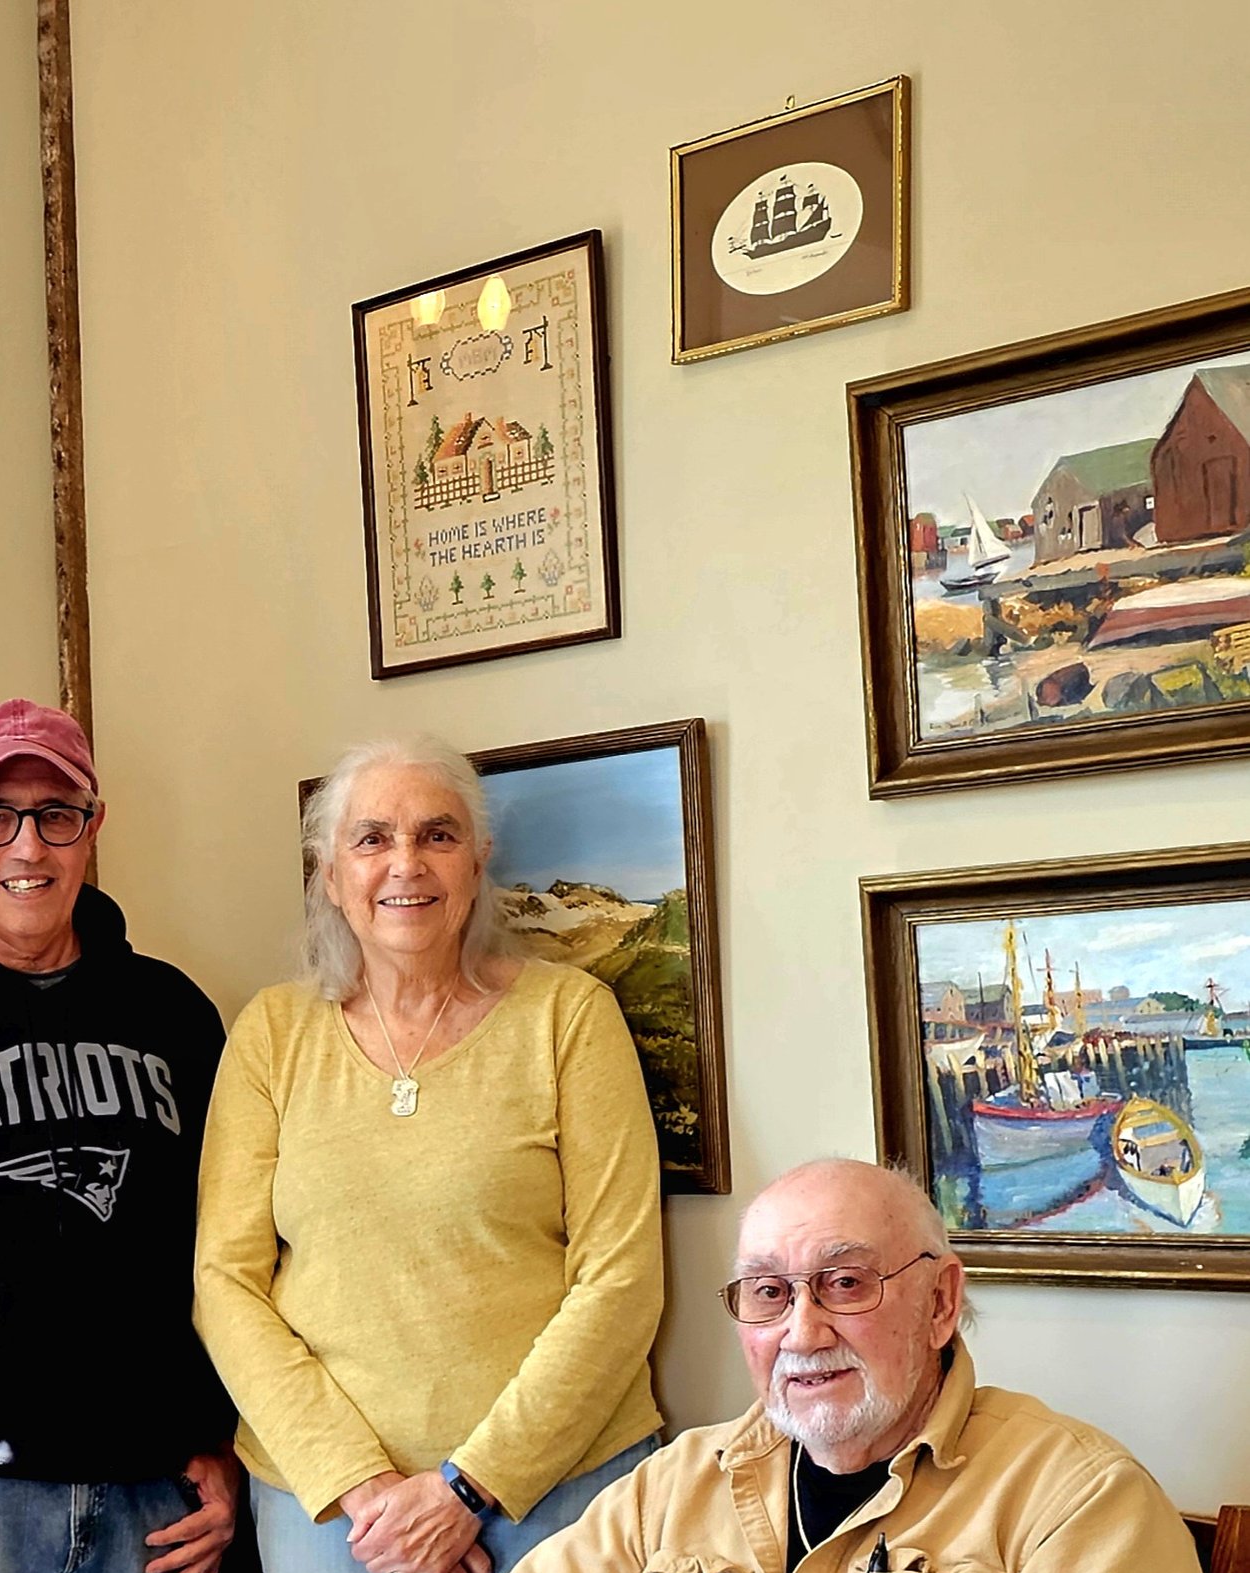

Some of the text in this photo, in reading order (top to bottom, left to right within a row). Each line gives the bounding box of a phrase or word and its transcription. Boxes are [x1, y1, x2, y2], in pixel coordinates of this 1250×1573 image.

[429, 507, 546, 547] HOME IS WHERE
[430, 529, 545, 567] THE HEARTH IS
